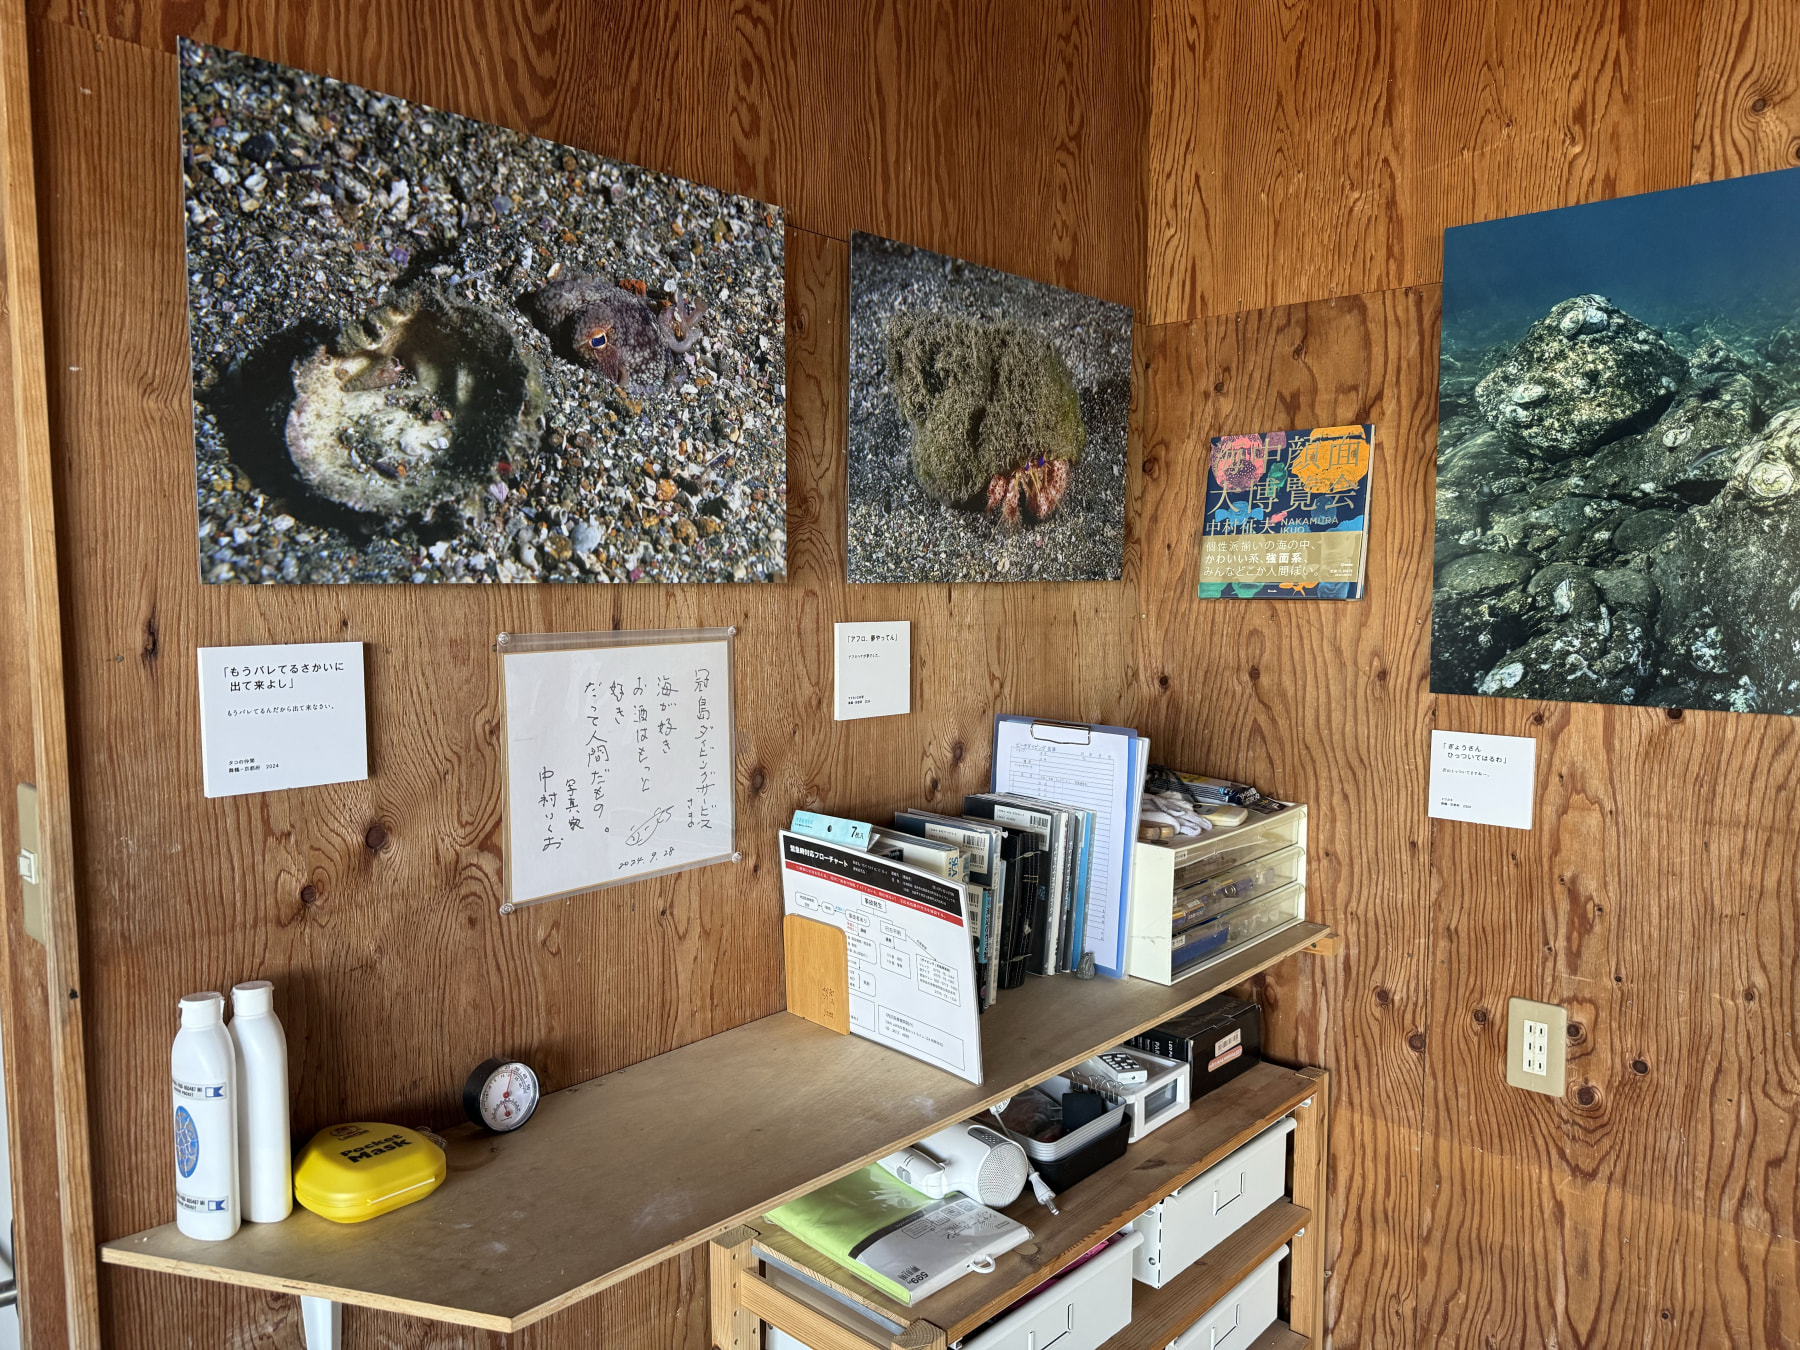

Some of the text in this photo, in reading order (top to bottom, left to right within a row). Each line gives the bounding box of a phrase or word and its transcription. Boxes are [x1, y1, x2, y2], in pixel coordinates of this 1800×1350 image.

[1215, 432, 1363, 475] 海中顔面
[1207, 474, 1360, 515] 大博覧会
[1281, 516, 1339, 526] NAKAMURA
[1206, 540, 1316, 552] 個性派揃いの海の中、
[1205, 552, 1308, 564] かわいい系、強面系、
[1203, 565, 1319, 577] みんなどこか人間ぽい。
[223, 661, 344, 678] 「もうバレてるさかいに
[230, 678, 294, 692] 出て来よし」
[227, 703, 335, 717] もうバレてるんだから出て来なさい。
[609, 680, 625, 725] 好き
[656, 675, 679, 754] 海が好き
[632, 676, 651, 792] お酒はもっと
[1447, 752, 1507, 764] ひっついてはるわ」
[340, 1134, 403, 1157] Pocket
[347, 1139, 413, 1163] Mask
